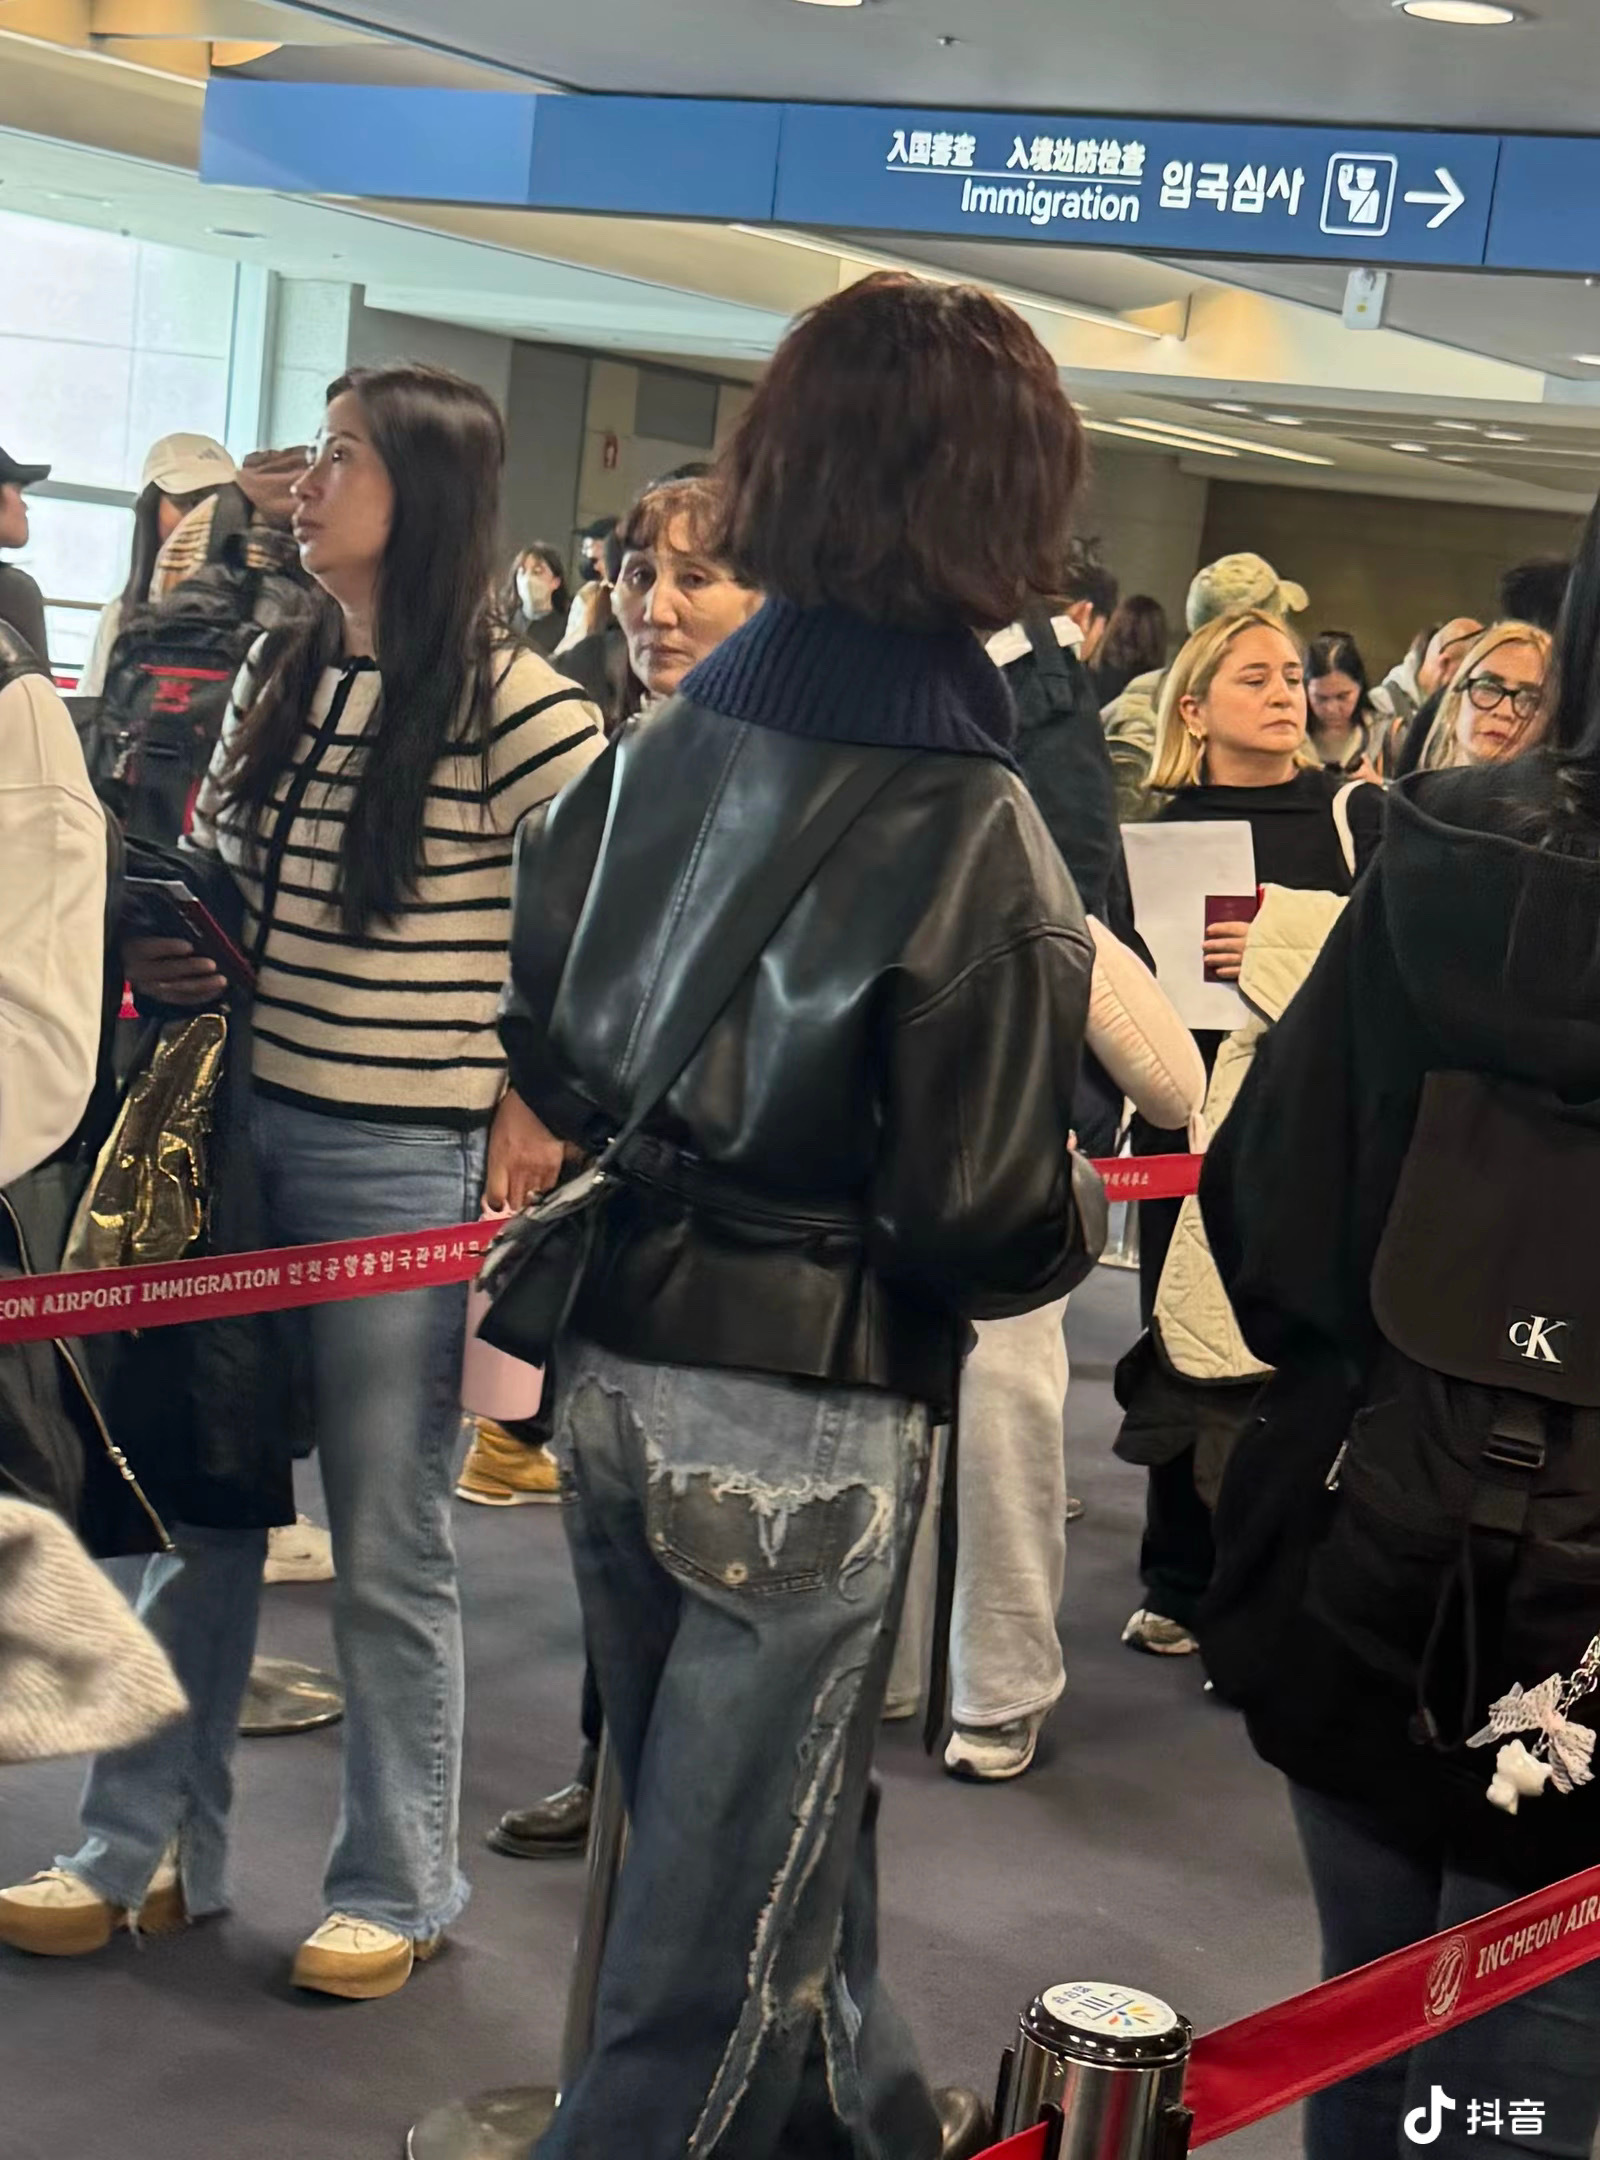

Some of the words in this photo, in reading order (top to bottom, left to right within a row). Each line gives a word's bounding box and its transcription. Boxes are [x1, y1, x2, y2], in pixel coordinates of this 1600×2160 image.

[961, 177, 1139, 225] Immigration
[1159, 161, 1304, 216] 입국심사
[41, 1284, 132, 1315] AIRPORT
[141, 1267, 281, 1303] IMMIGRATION
[1475, 1911, 1564, 1979] INCHEON
[1563, 1895, 1600, 1935] AIR
